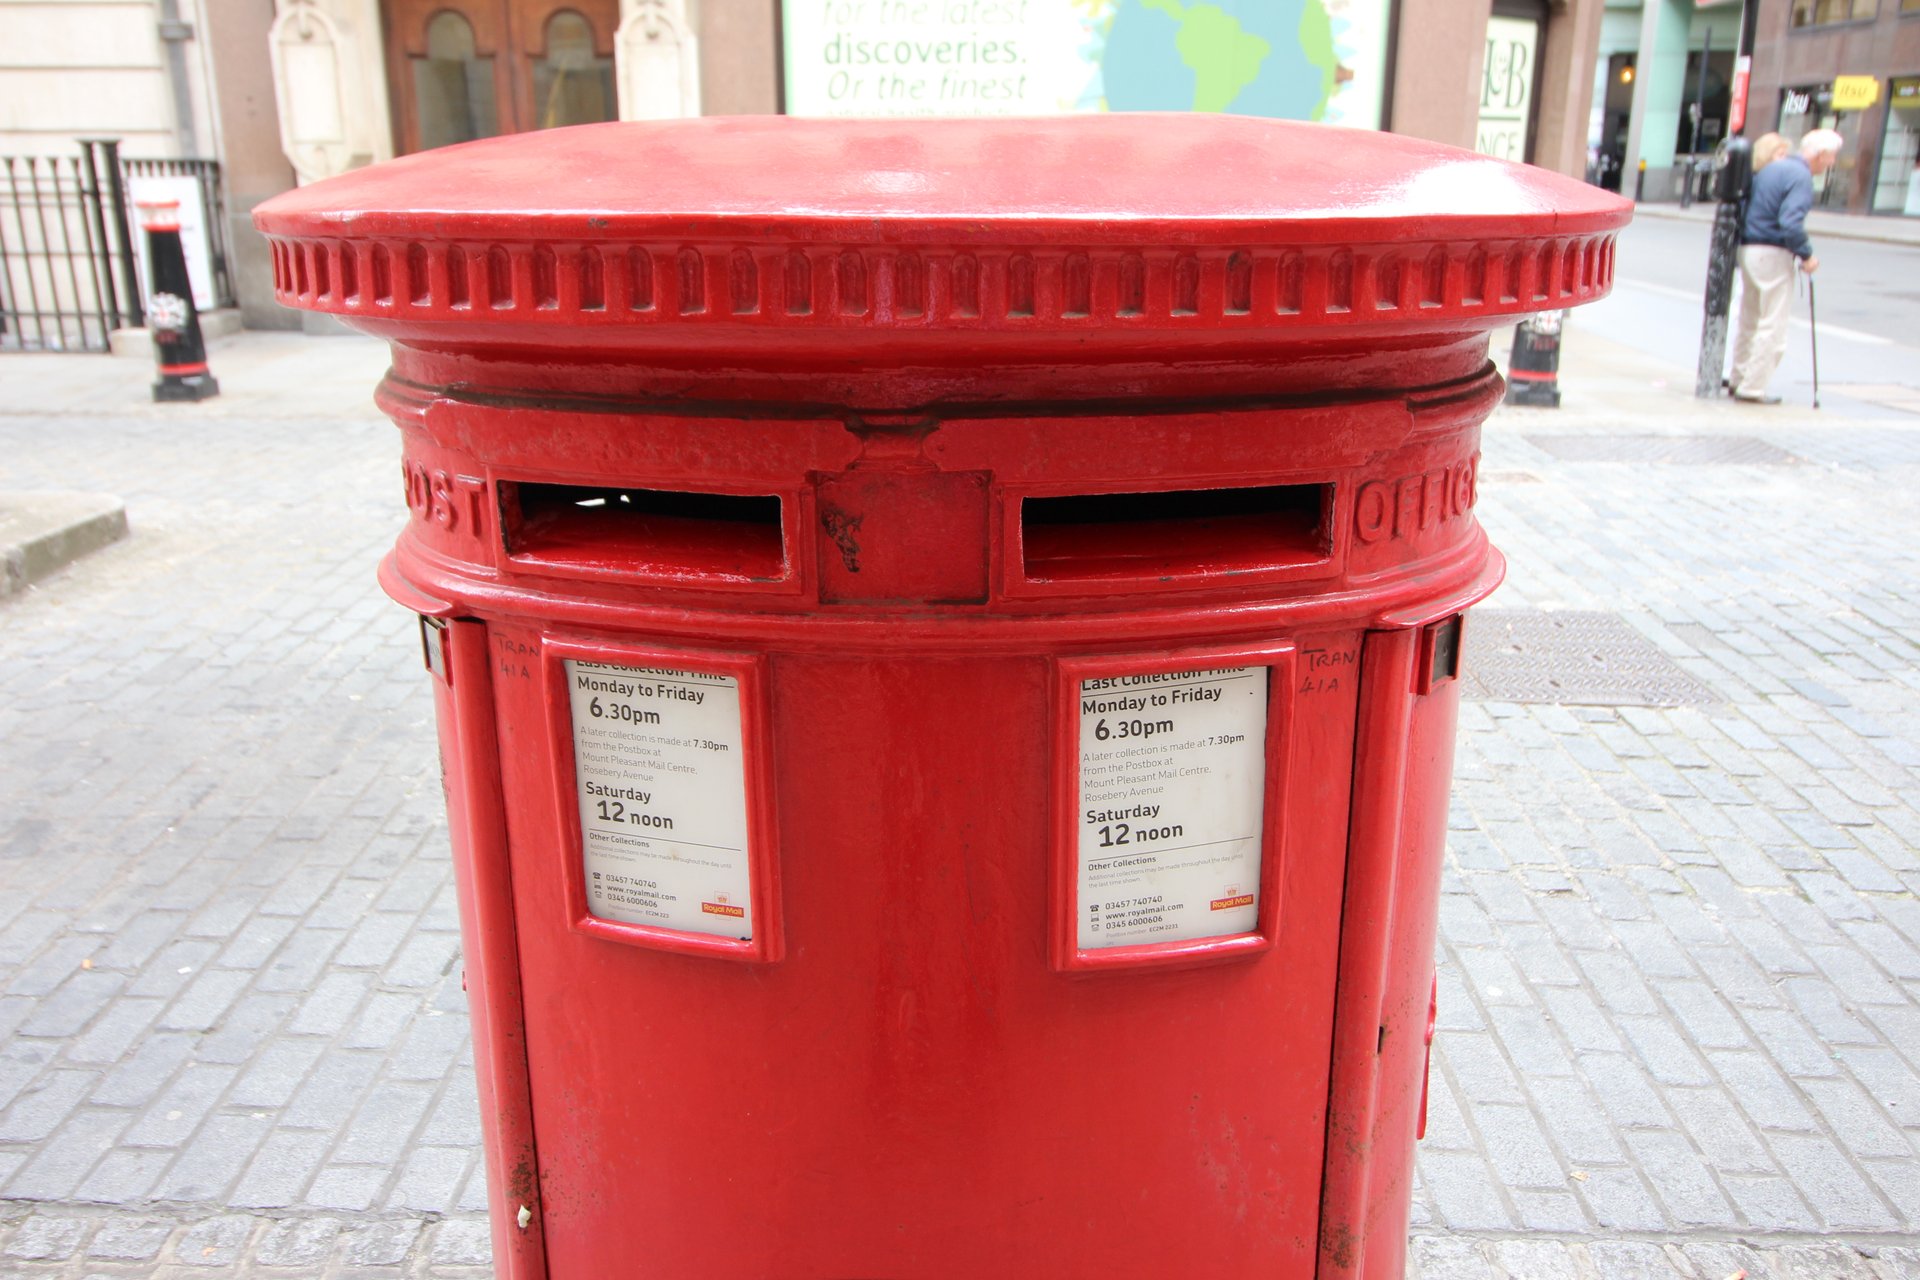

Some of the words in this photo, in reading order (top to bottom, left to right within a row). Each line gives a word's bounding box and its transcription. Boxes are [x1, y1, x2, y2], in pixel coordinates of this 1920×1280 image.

[823, 32, 1027, 65] discoveries.
[827, 69, 864, 101] Or
[878, 71, 926, 100] the
[939, 69, 1027, 101] finest
[1301, 648, 1357, 672] TRAN
[577, 676, 634, 697] Monday
[638, 683, 653, 697] to
[657, 684, 705, 705] Friday
[1081, 677, 1117, 691] Last
[589, 696, 661, 726] 6.30pm
[1082, 697, 1146, 715] Monday
[1150, 694, 1167, 706] to
[1172, 687, 1222, 704] Friday
[580, 726, 587, 735] A
[588, 726, 607, 738] later
[608, 729, 647, 743] collection
[649, 734, 656, 744] is
[657, 735, 682, 748] made
[682, 738, 692, 748] at
[693, 738, 729, 752] 7.30pm
[1094, 718, 1174, 741] 6.30pm
[581, 739, 601, 751] from
[602, 741, 617, 752] the
[618, 743, 652, 756] Postbox
[653, 747, 661, 757] at
[1083, 753, 1090, 762] A
[1092, 751, 1112, 762] later
[1115, 745, 1158, 759] collection
[1160, 744, 1168, 753] is
[1170, 740, 1195, 752] made
[1196, 739, 1206, 749] at
[1208, 733, 1245, 747] 7.30pm
[582, 751, 610, 765] Mount
[611, 754, 647, 768] Pleasant
[648, 759, 666, 772] Mail
[1083, 765, 1106, 777] from
[1108, 761, 1124, 773] the
[1126, 758, 1163, 772] Postbox
[1164, 757, 1174, 767] at
[583, 764, 621, 779] Rosebery
[623, 769, 654, 782] Avenue
[1084, 776, 1115, 789] Mount
[1117, 772, 1156, 785] Pleasant
[1158, 768, 1177, 780] Mail
[586, 781, 651, 805] Saturday
[1085, 791, 1127, 803] Rosebery
[1129, 785, 1164, 798] Avenue
[597, 800, 625, 823] 12
[630, 811, 674, 830] noon
[1086, 804, 1160, 824] Saturday
[589, 832, 610, 843] Other
[611, 835, 650, 848] Collections
[1098, 823, 1130, 847] 12
[1136, 824, 1183, 842] noon
[1088, 862, 1111, 872] Other
[1113, 856, 1156, 868] Collections
[606, 874, 628, 884] 03457
[630, 877, 657, 889] 740740
[607, 885, 677, 901] www.royalmail.com
[607, 893, 625, 902] 0345
[626, 897, 658, 908] 6000606
[1105, 900, 1131, 910] 03457
[1133, 895, 1163, 907] 740740
[1212, 898, 1234, 909] Royal
[1235, 894, 1252, 905] Mail
[703, 903, 725, 914] Royal
[726, 907, 743, 916] Mail
[1105, 903, 1184, 920] www.royalmail.com
[1106, 921, 1126, 930] 0345
[1128, 915, 1163, 927] 6000606
[1149, 925, 1164, 933] EC2M
[1165, 923, 1179, 931] 2231
